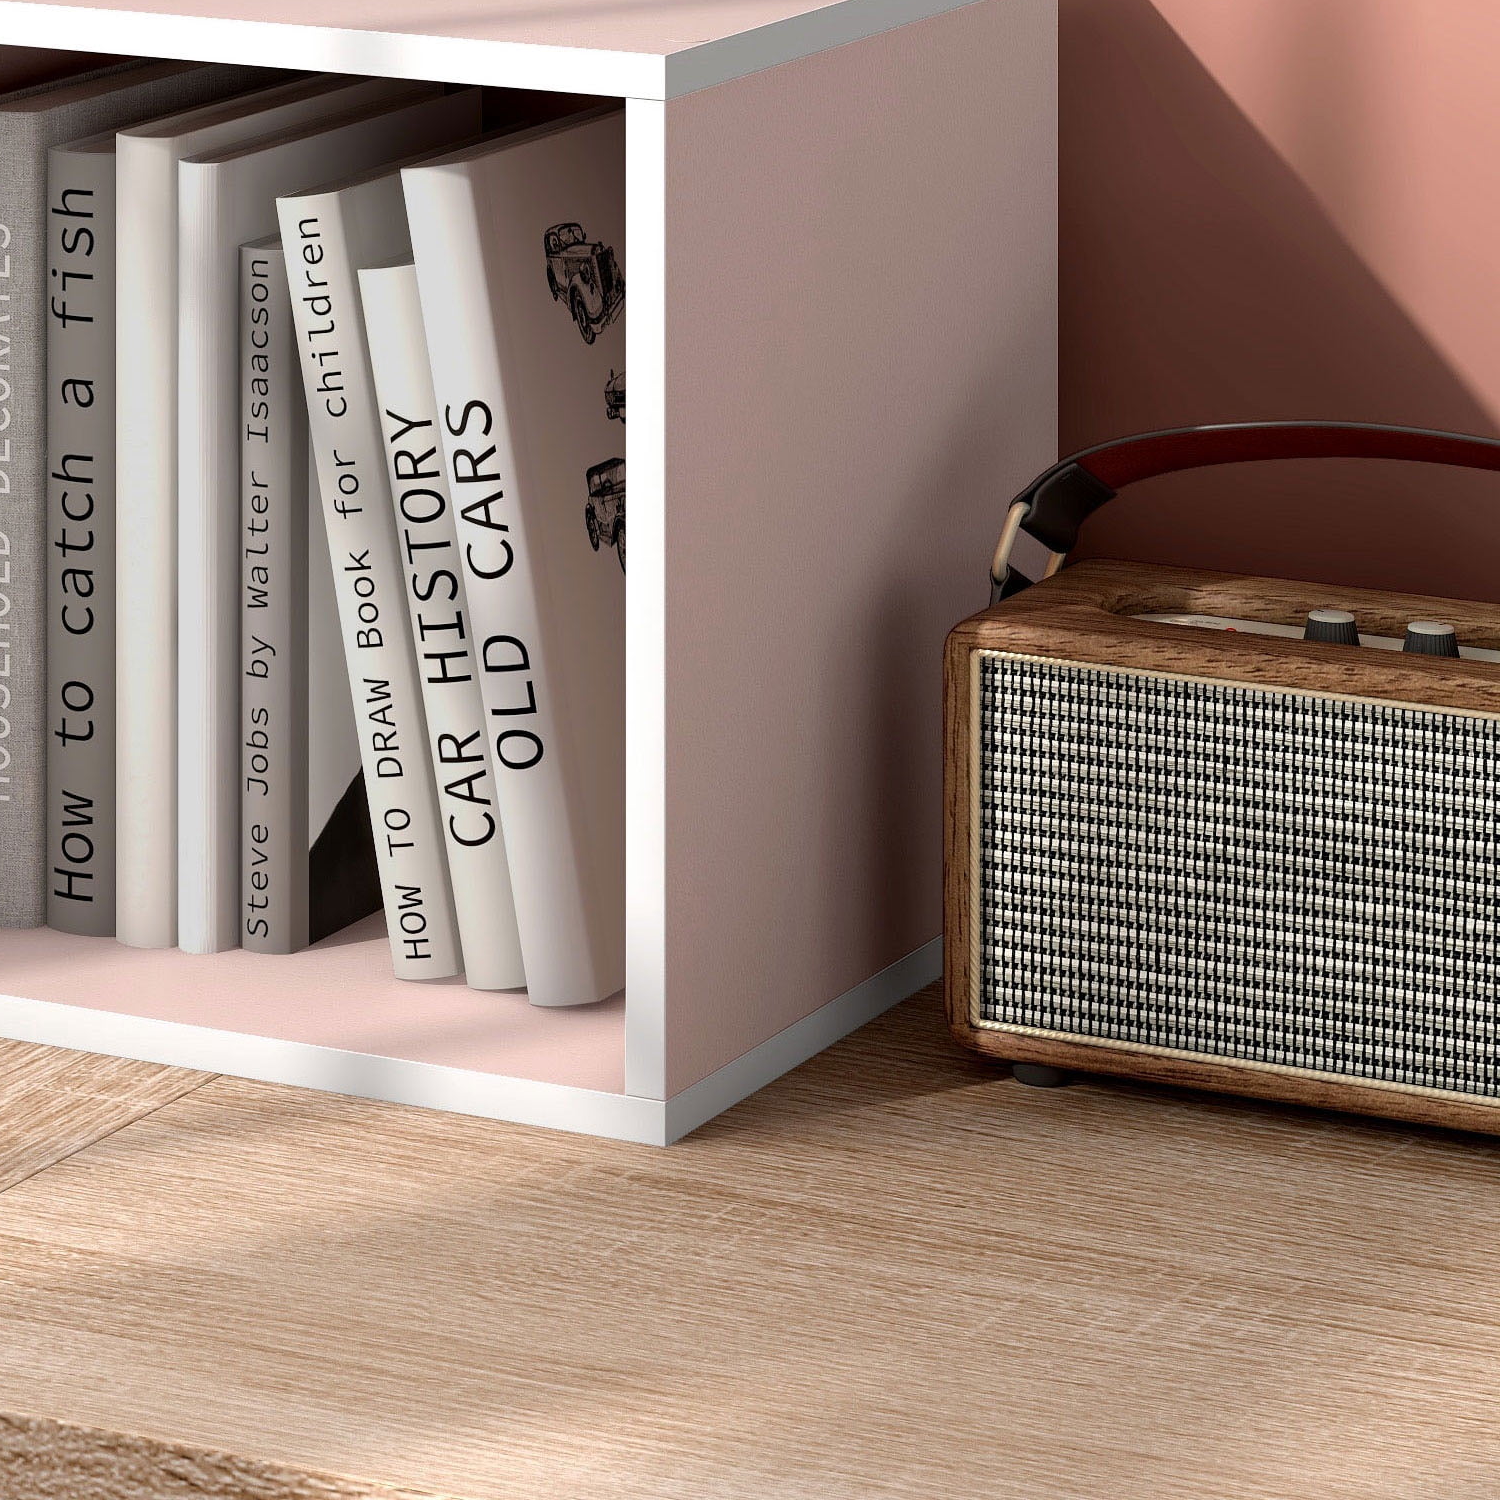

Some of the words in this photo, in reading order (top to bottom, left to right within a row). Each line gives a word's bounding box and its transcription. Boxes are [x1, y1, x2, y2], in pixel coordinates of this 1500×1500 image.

[51, 188, 94, 328] fish
[247, 259, 269, 443] Isaacson
[298, 217, 347, 418] children
[61, 378, 94, 408] a
[246, 470, 269, 608] Walter
[333, 449, 363, 520] for
[445, 400, 514, 580] CARS
[51, 454, 94, 635] catch
[344, 549, 383, 648] Book
[386, 408, 473, 684] HISTORY
[54, 680, 94, 747] to
[246, 635, 276, 678] by
[482, 634, 544, 770] OLD
[246, 706, 269, 796] Jobs
[363, 678, 404, 778] DRAW
[384, 808, 414, 858] TO
[437, 729, 496, 847] CAR
[54, 789, 94, 902] How
[247, 823, 269, 938] Steve
[394, 884, 432, 960] HOW
